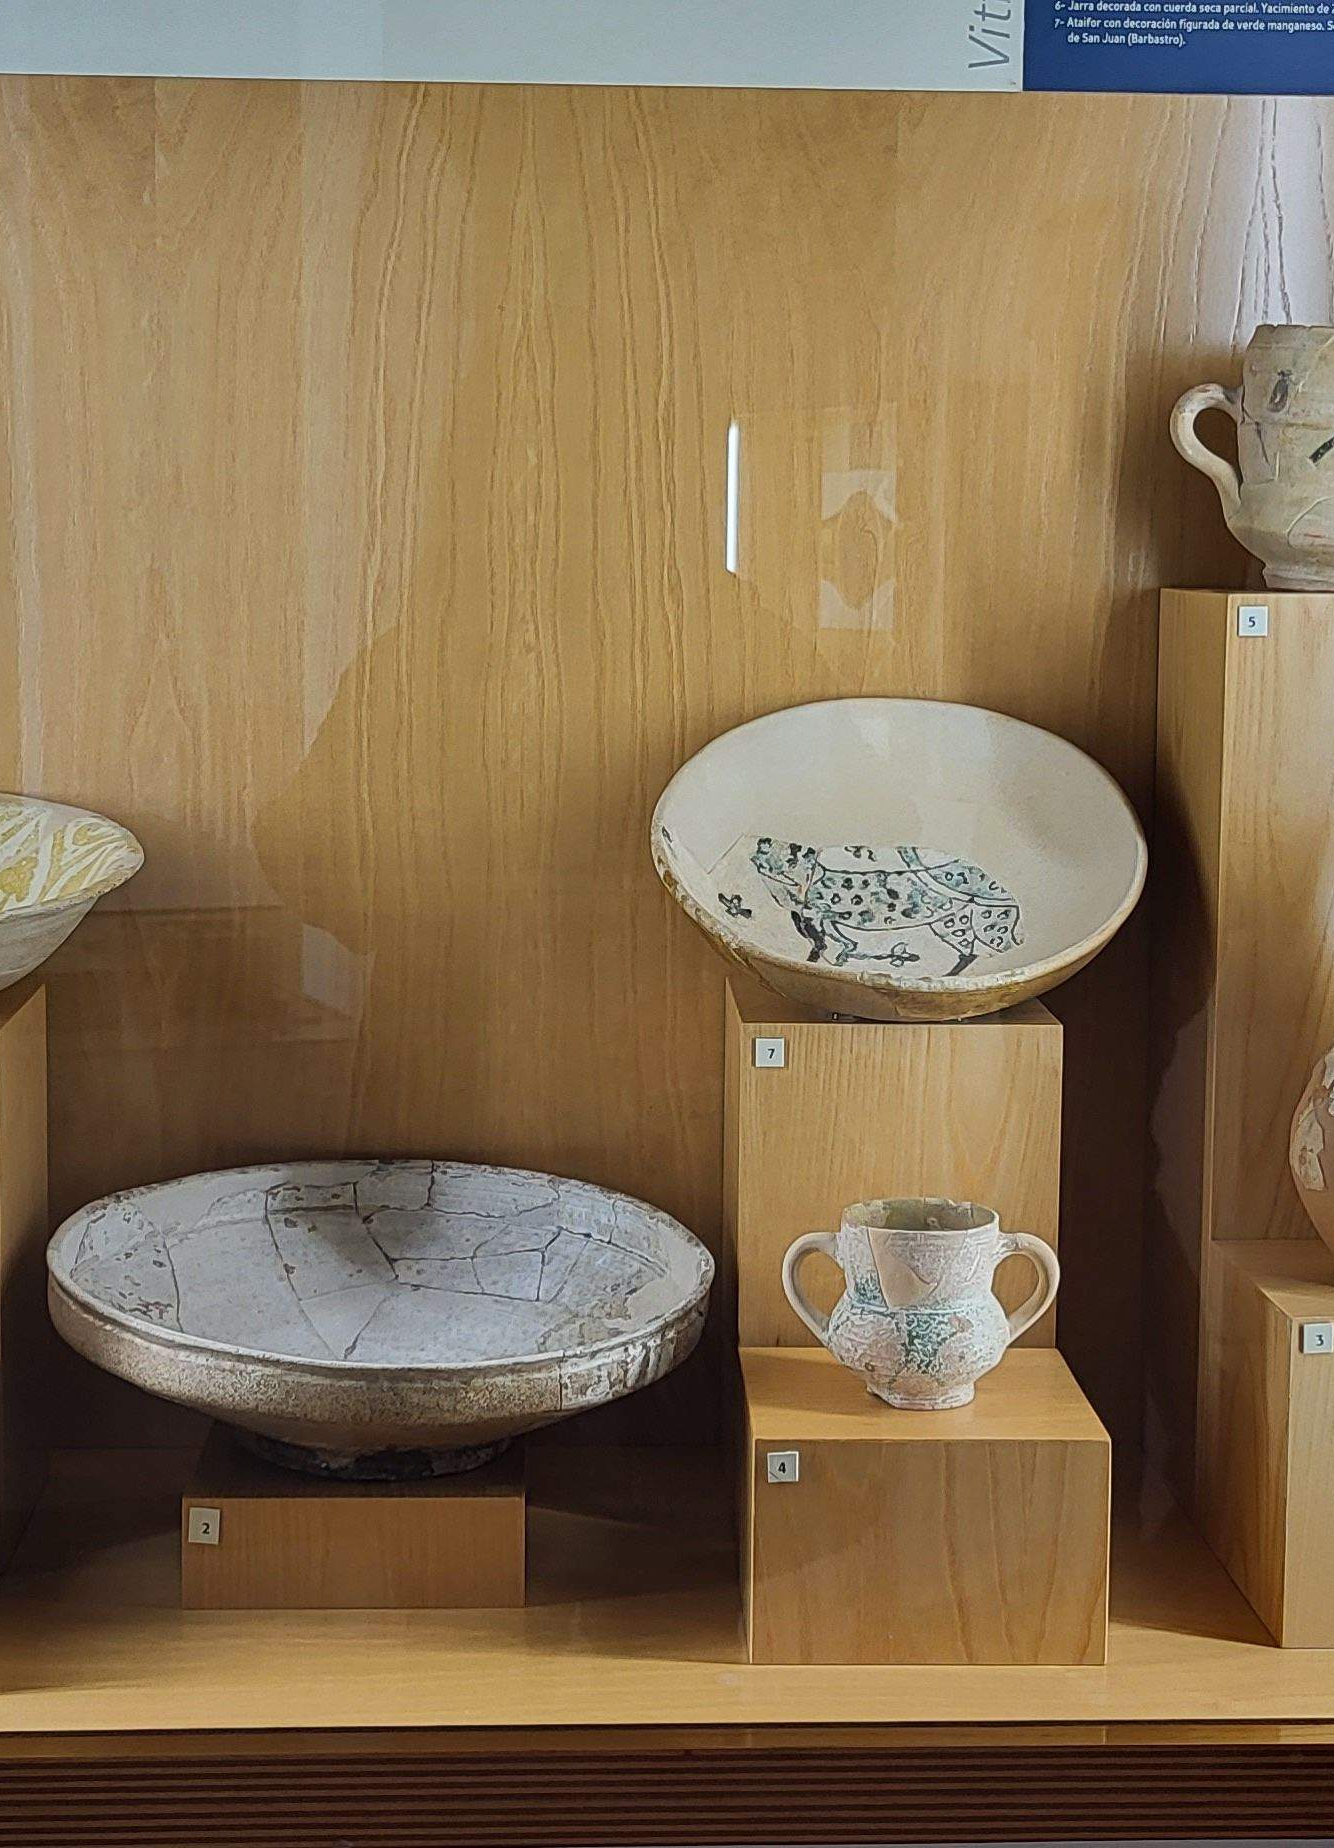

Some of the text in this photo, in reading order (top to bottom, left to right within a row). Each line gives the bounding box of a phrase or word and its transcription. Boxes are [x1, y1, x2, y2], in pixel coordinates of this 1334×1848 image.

[1068, 1, 1094, 12] Jarra
[1097, 1, 1141, 12] decorada
[1144, 3, 1161, 12] con
[1164, 2, 1196, 13] cuerda
[1199, 5, 1221, 13] seca
[1224, 3, 1259, 15] parcial.
[1262, 4, 1314, 14] Yacimiento
[1317, 4, 1329, 14] de
[1067, 17, 1101, 28] Ataifor
[1104, 20, 1121, 28] con
[1123, 18, 1177, 29] decoración
[1179, 19, 1219, 32] figurada
[1222, 20, 1234, 30] de
[1237, 20, 1265, 30] verde
[1268, 22, 1325, 33] manganeso.
[968, 0, 1011, 68] Vit
[1068, 32, 1186, 47] de San Juan (Barbastro).
[1249, 616, 1256, 628] 5
[767, 1048, 775, 1059] 7
[1316, 1335, 1324, 1347] 3
[777, 1462, 786, 1474] 4
[202, 1523, 210, 1534] 2
